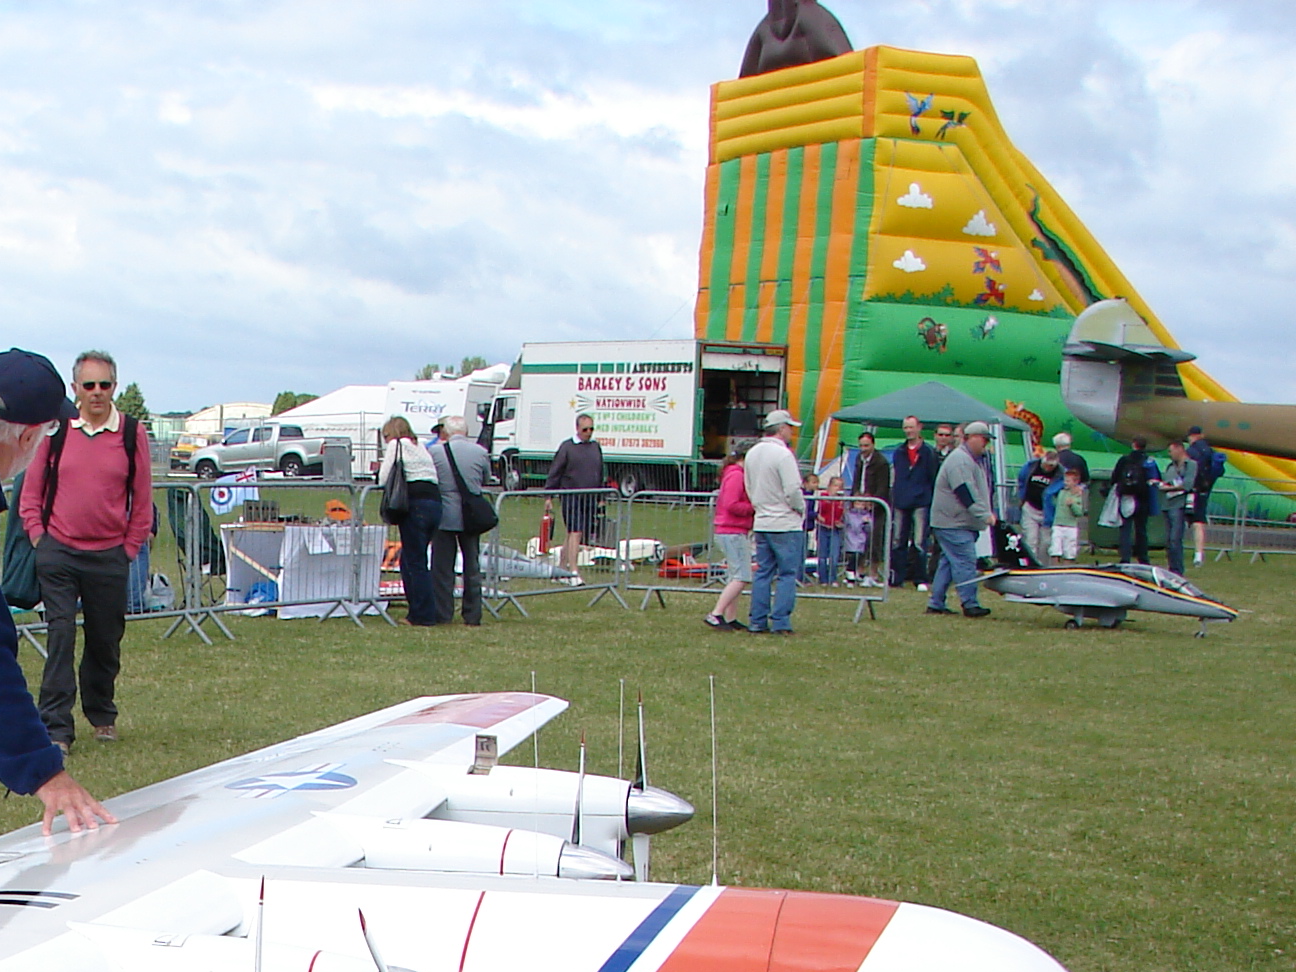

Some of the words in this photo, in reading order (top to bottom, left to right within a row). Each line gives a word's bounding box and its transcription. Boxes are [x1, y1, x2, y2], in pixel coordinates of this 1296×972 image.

[577, 376, 622, 391] BARLEY
[625, 377, 635, 391] &
[638, 376, 667, 391] SONS
[595, 397, 646, 409] NATIONWIDE
